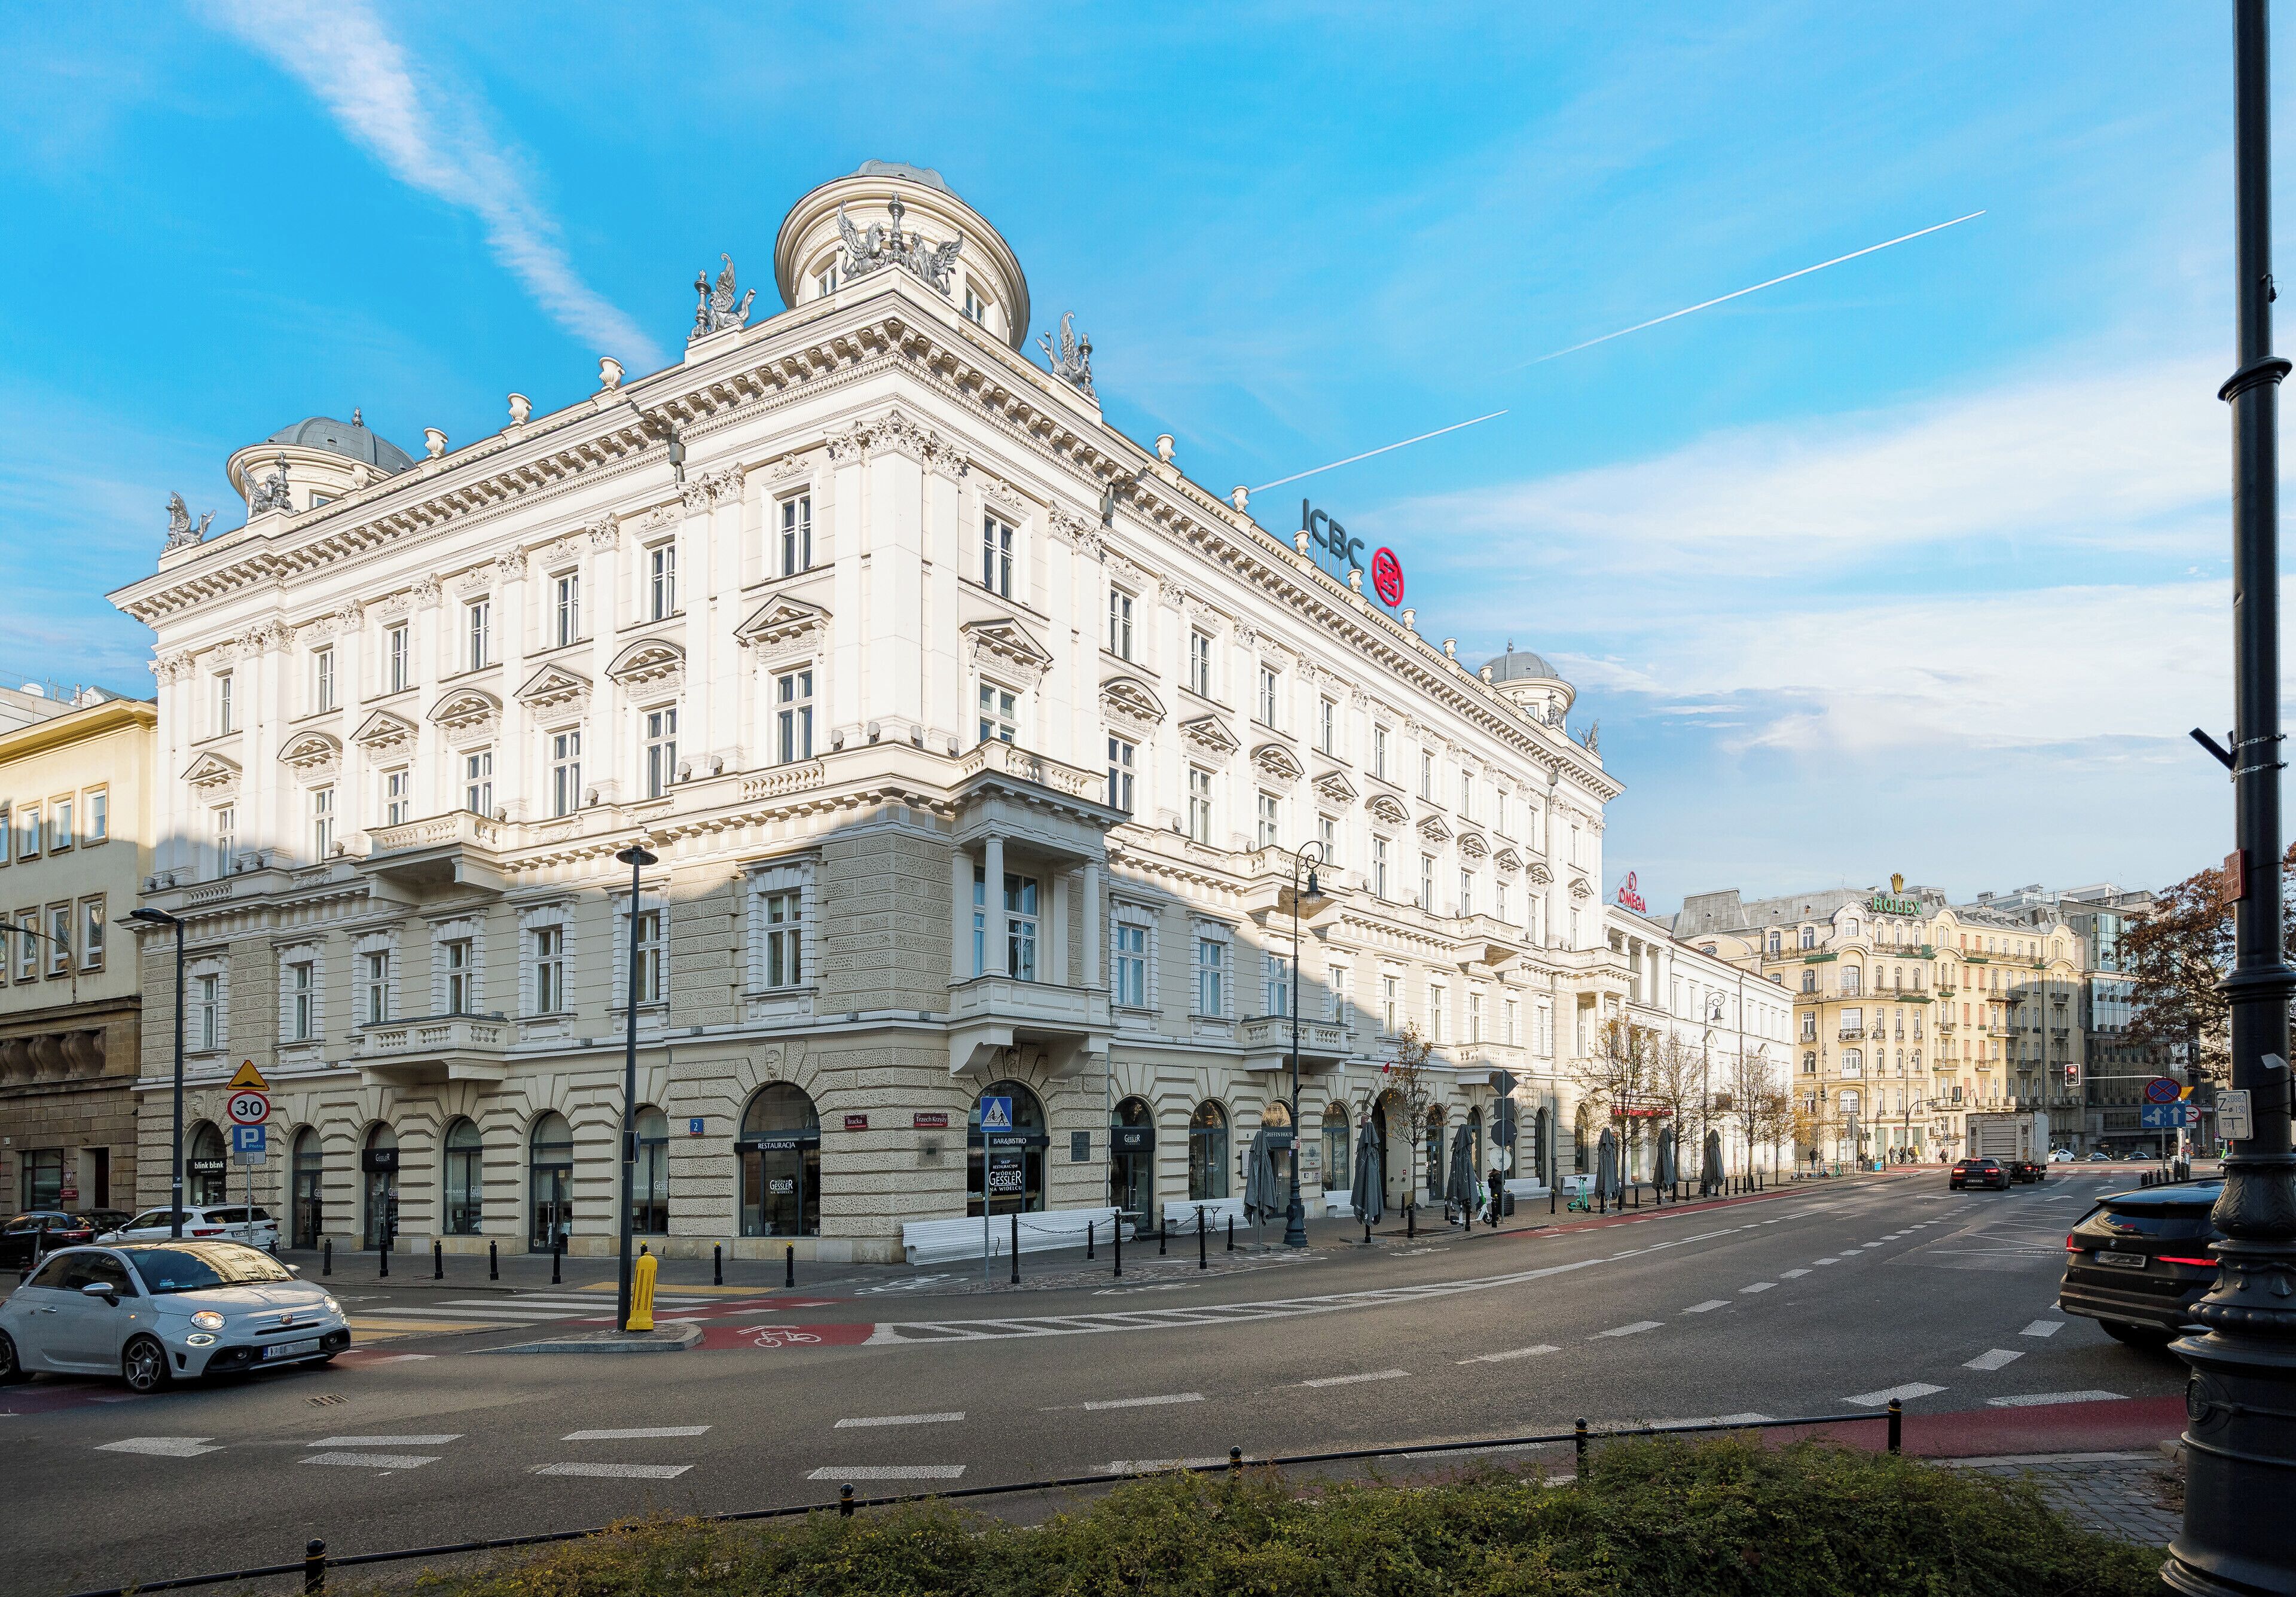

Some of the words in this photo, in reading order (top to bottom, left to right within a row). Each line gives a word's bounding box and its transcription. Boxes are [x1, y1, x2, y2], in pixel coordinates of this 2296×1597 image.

[1302, 498, 1364, 574] ICBC
[1618, 887, 1646, 913] OMEGA
[1873, 896, 1922, 915] ROLEX
[235, 1100, 262, 1116] 30
[2218, 1098, 2227, 1111] Z
[694, 1122, 697, 1131] 2
[241, 1128, 258, 1148] P
[1124, 1134, 1140, 1143] GESSLER
[770, 1179, 793, 1190] GESSLER
[989, 1171, 1022, 1185] GESSLER
